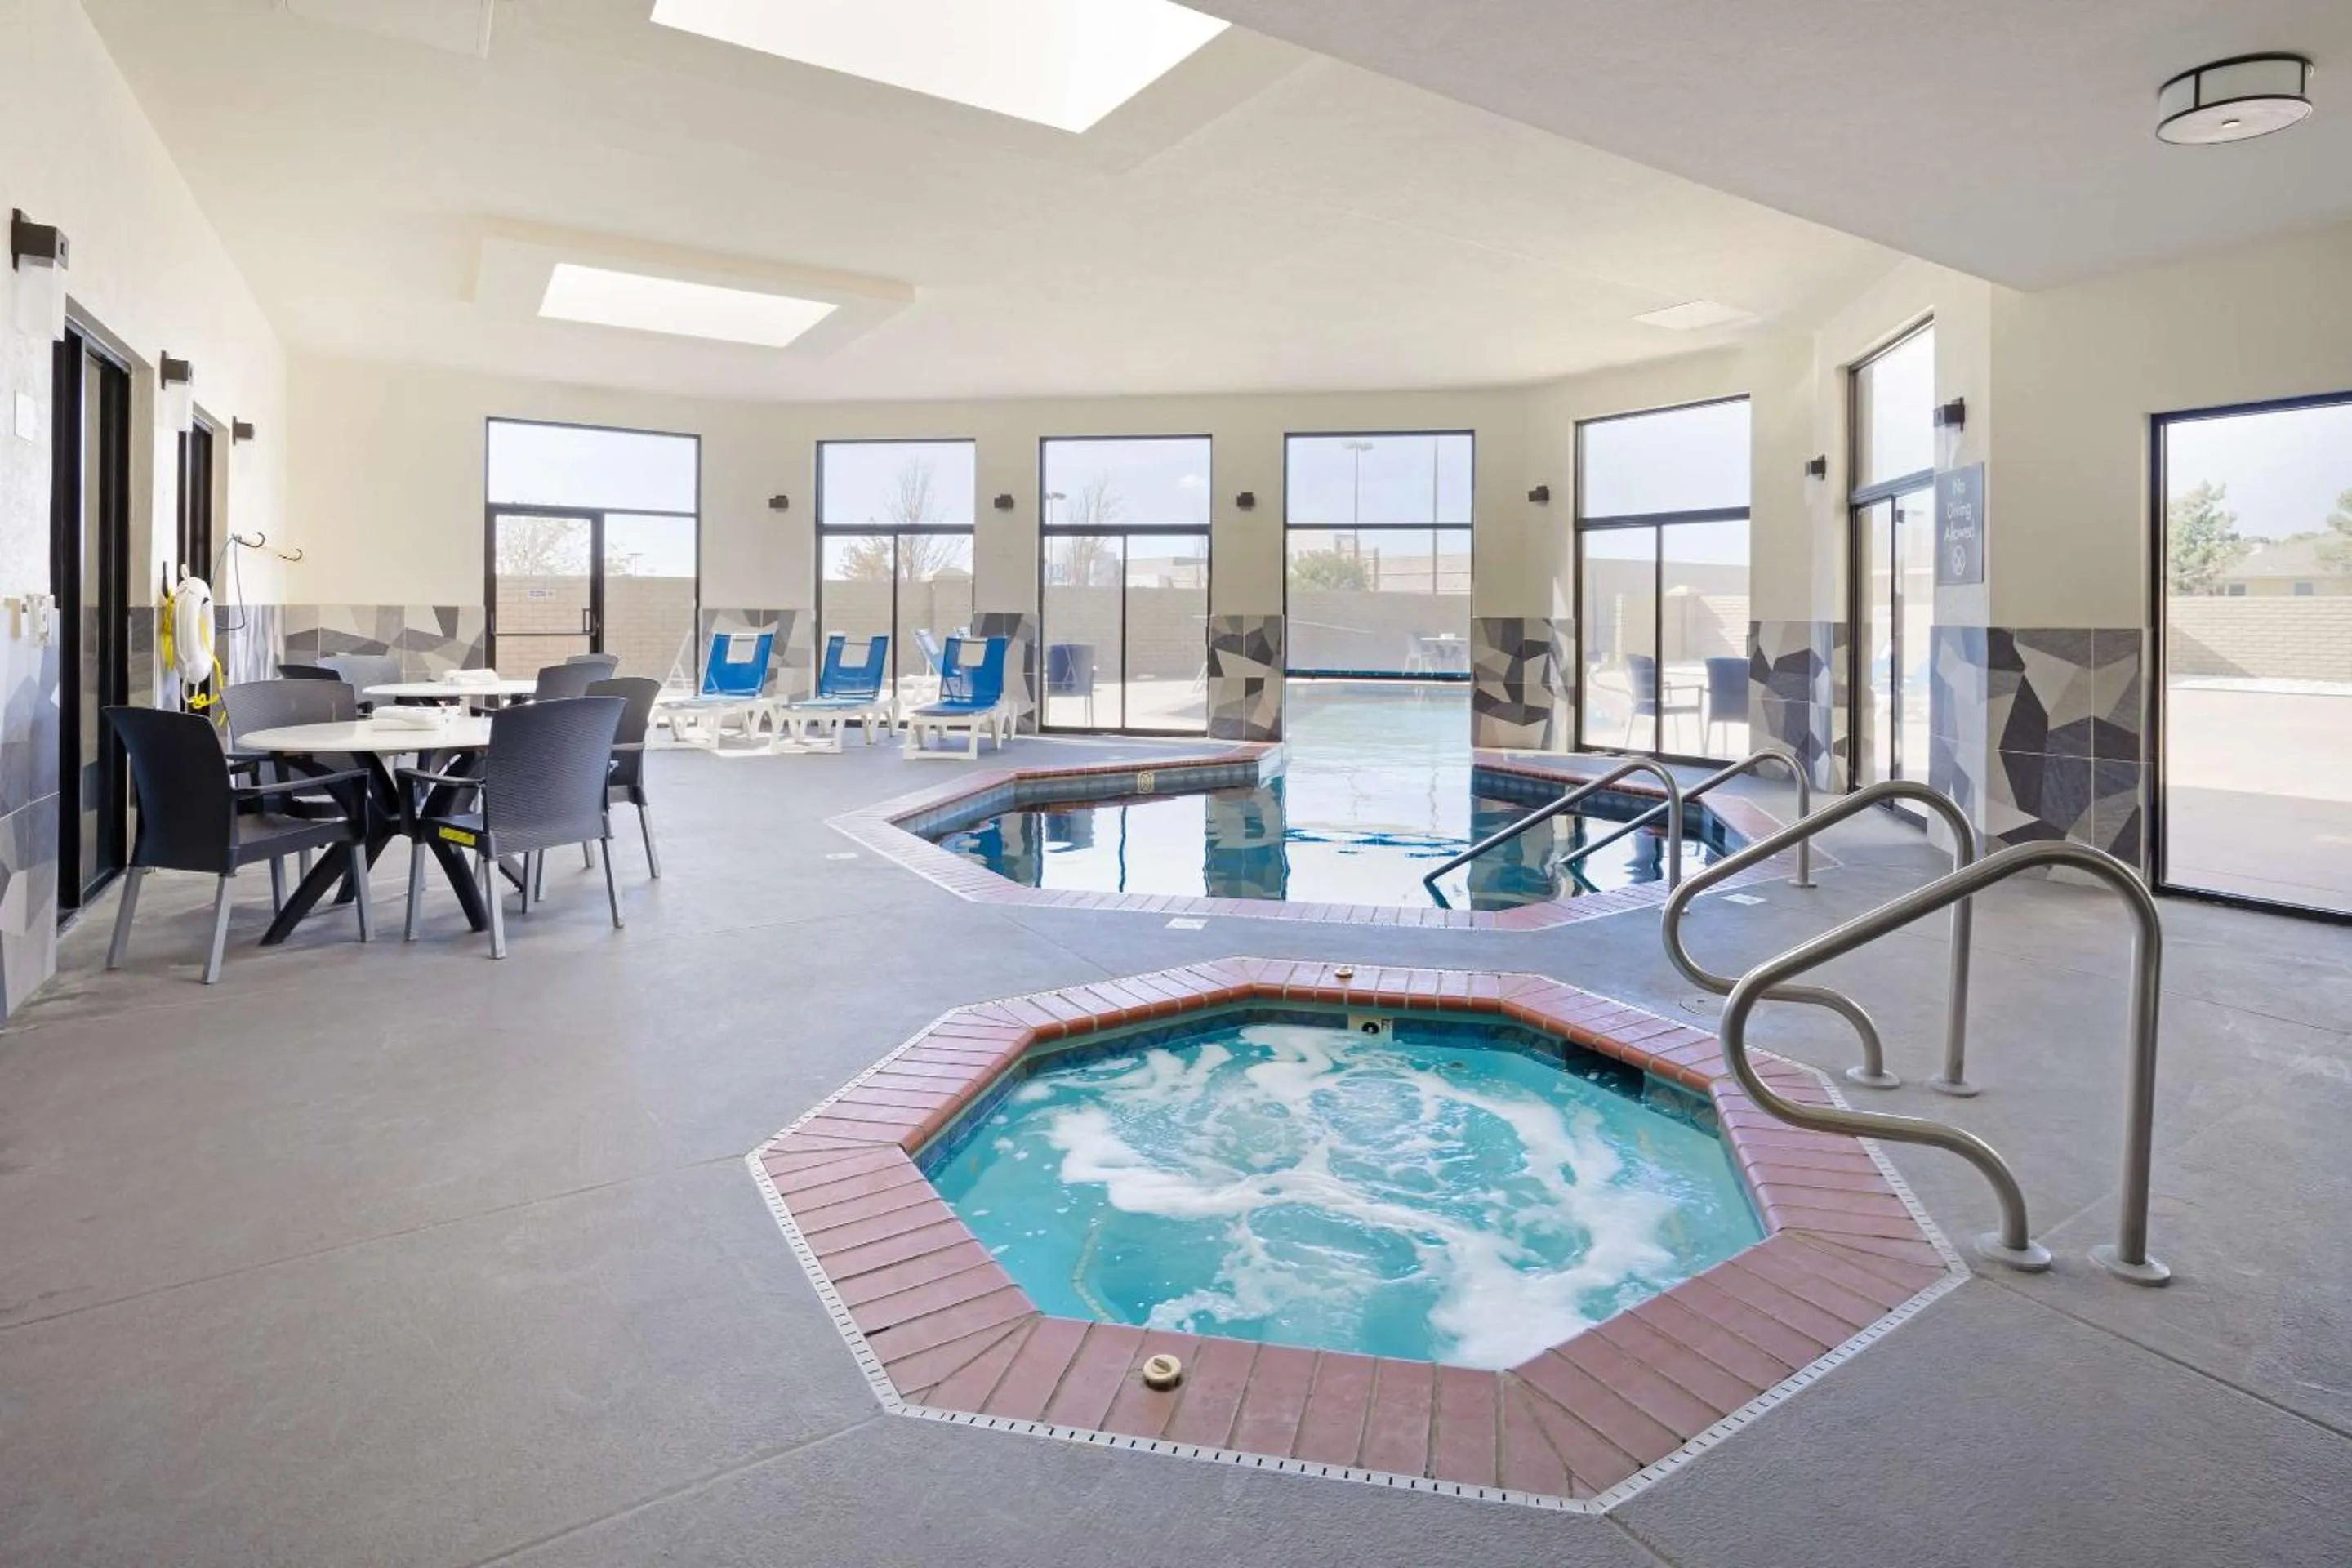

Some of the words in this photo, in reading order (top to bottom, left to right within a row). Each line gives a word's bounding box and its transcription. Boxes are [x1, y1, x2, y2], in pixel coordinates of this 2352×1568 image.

[1953, 478, 1965, 495] No
[1947, 501, 1972, 520] Diving
[1944, 519, 1975, 541] Allowed
